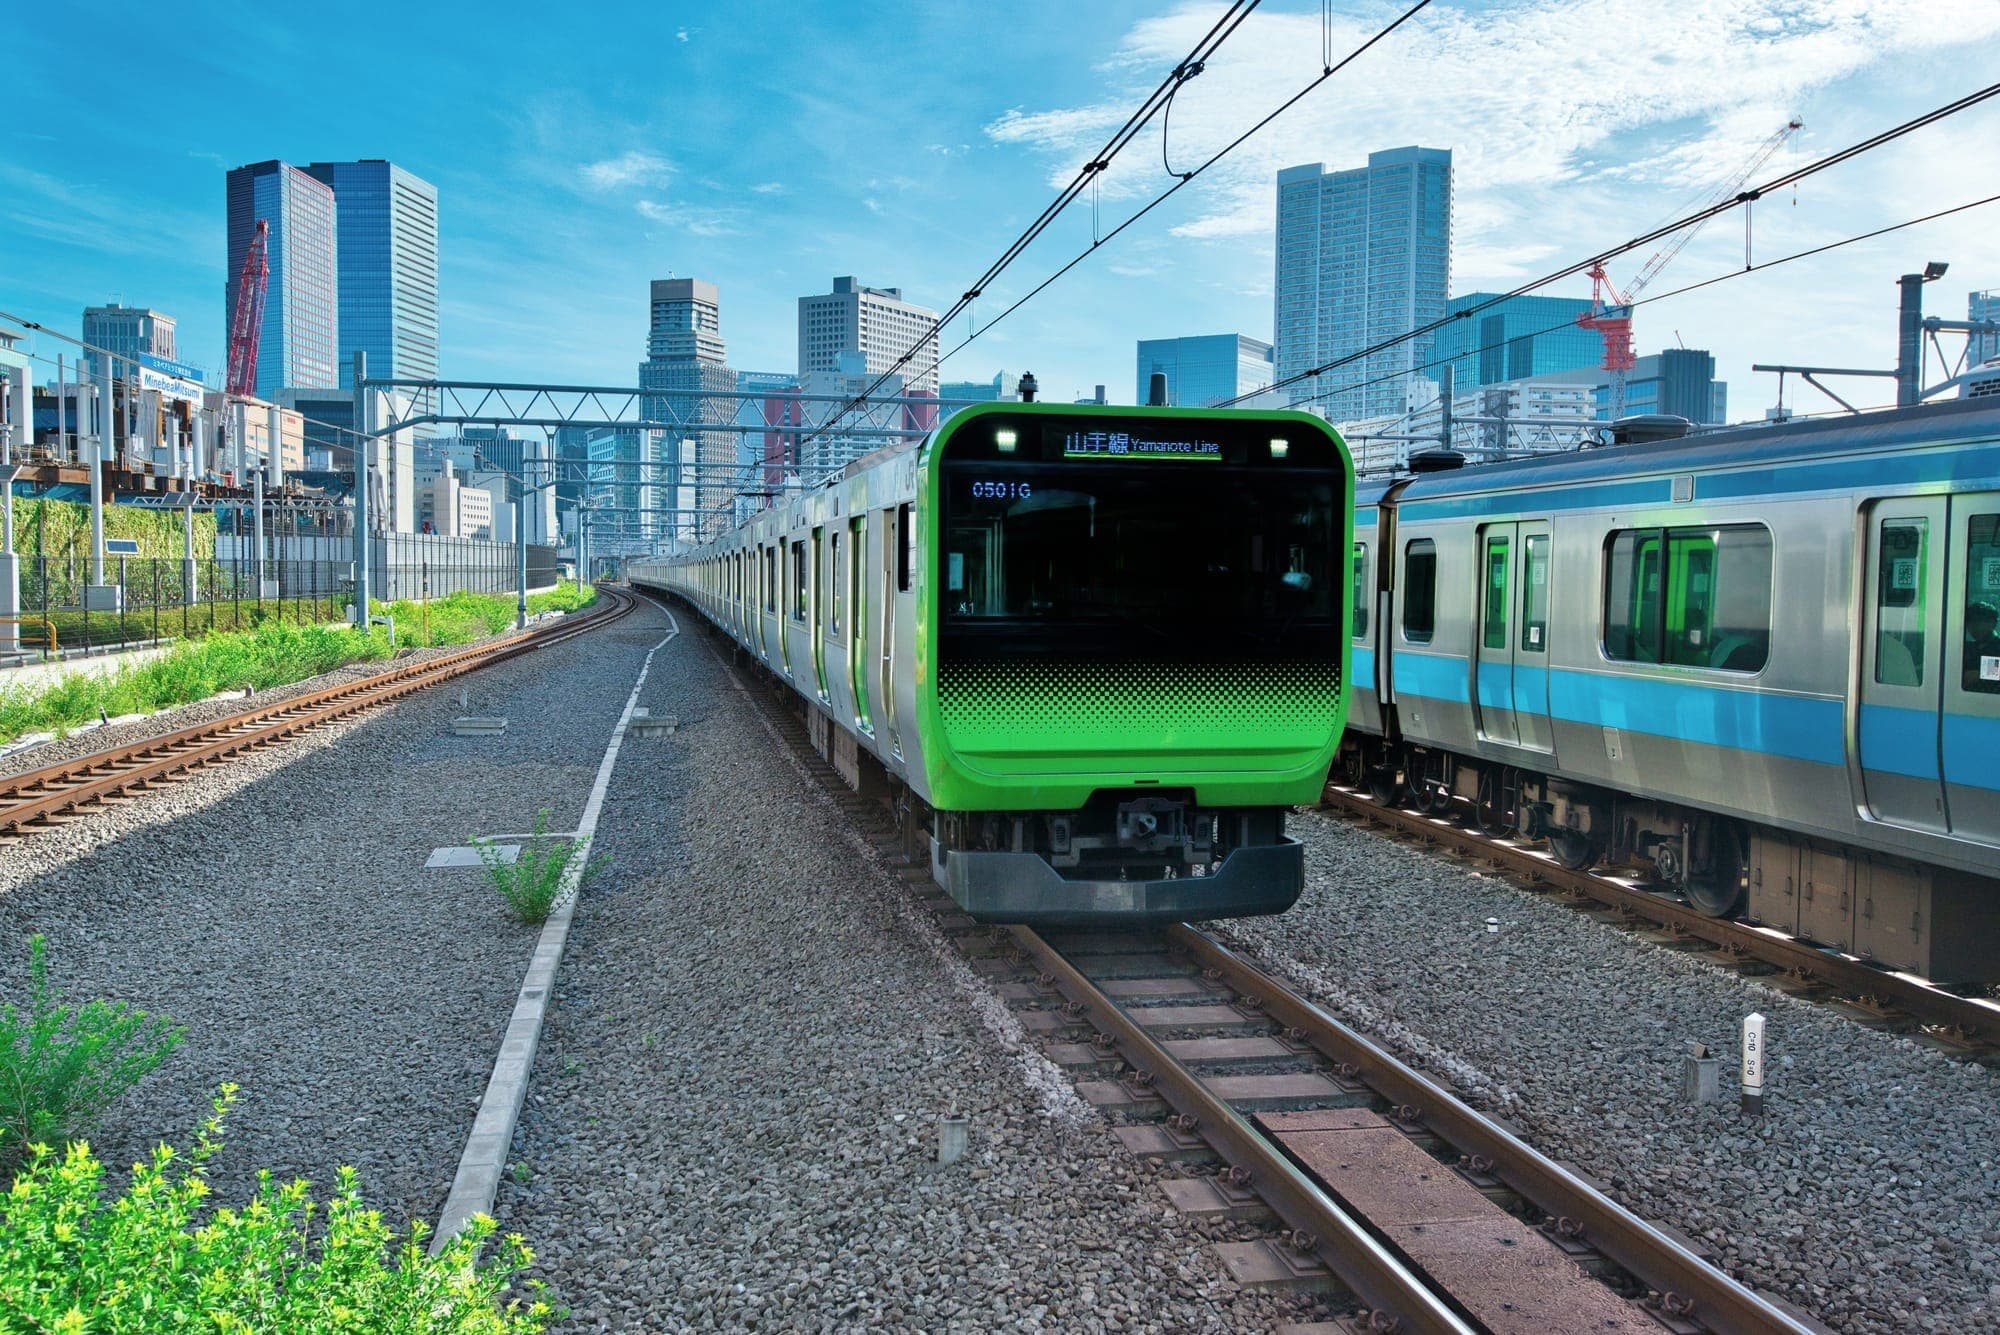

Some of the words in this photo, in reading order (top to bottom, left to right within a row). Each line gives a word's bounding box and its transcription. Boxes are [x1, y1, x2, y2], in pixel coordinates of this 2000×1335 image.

[144, 373, 200, 400] MinebeaMitsumi
[1066, 432, 1129, 454] 山手線
[1130, 438, 1191, 452] Yamanote
[1195, 440, 1219, 453] Line
[972, 481, 1032, 499] 0501G
